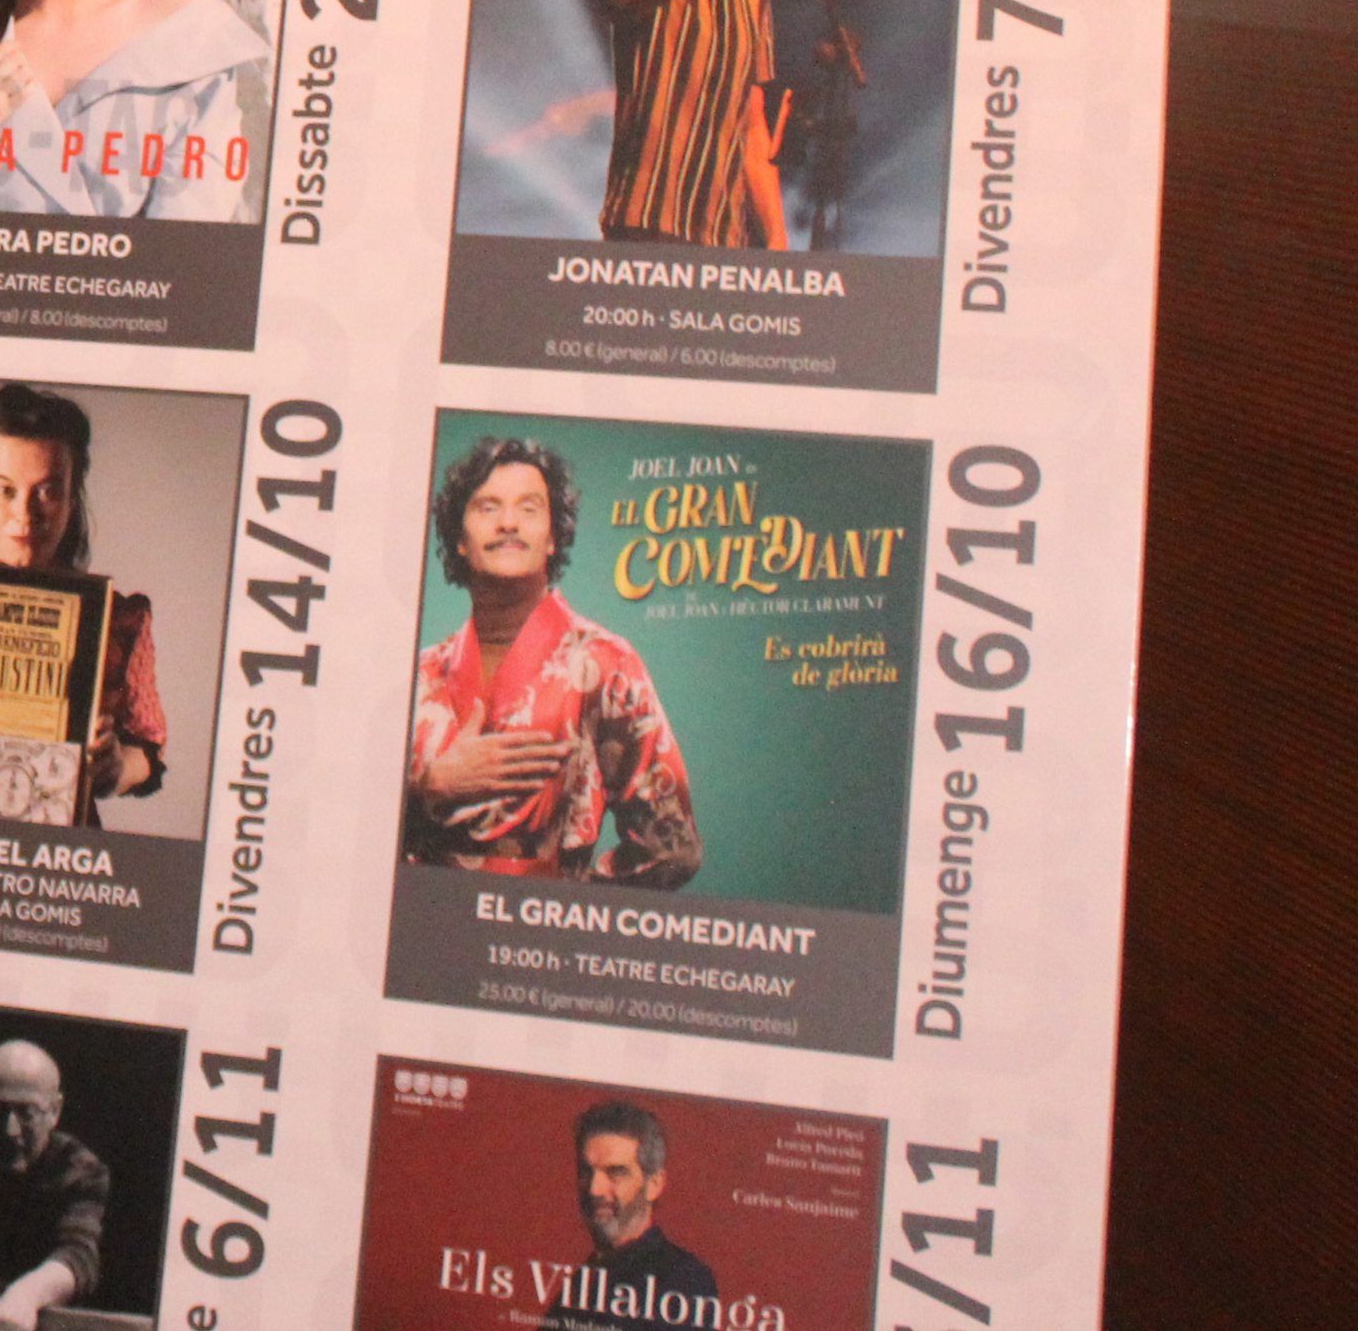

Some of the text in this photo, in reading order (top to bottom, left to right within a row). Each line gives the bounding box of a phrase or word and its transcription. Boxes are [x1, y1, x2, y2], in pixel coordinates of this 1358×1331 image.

[61, 130, 249, 182] PEDRO
[280, 44, 337, 246] Dissabte
[961, 66, 1021, 314] Divendres
[36, 231, 133, 259] PEDRO
[54, 275, 172, 299] ECHEGARAY
[547, 256, 846, 298] JONATAN PENALBA
[583, 305, 638, 326] 20:00
[668, 310, 725, 332] SALA
[729, 314, 802, 336] GOMIS
[644, 481, 758, 535] GRAN
[614, 515, 905, 600] COMEDIANT
[764, 635, 792, 661] Es
[792, 662, 821, 686] de
[213, 398, 344, 955] Divendres 14/10
[915, 443, 1042, 1042] Diumenge 16/10
[32, 844, 113, 877] ARGA
[15, 900, 83, 927] GOMIS
[39, 877, 141, 908] NAVARRA
[476, 892, 817, 957] EL GRAN COMEDIANT
[487, 944, 544, 969] 19:00
[575, 952, 656, 984] TEATRE
[661, 963, 796, 998] ECHEGARAY
[181, 1046, 282, 1280] 6/11
[438, 1246, 785, 1331] Els Villalonga
